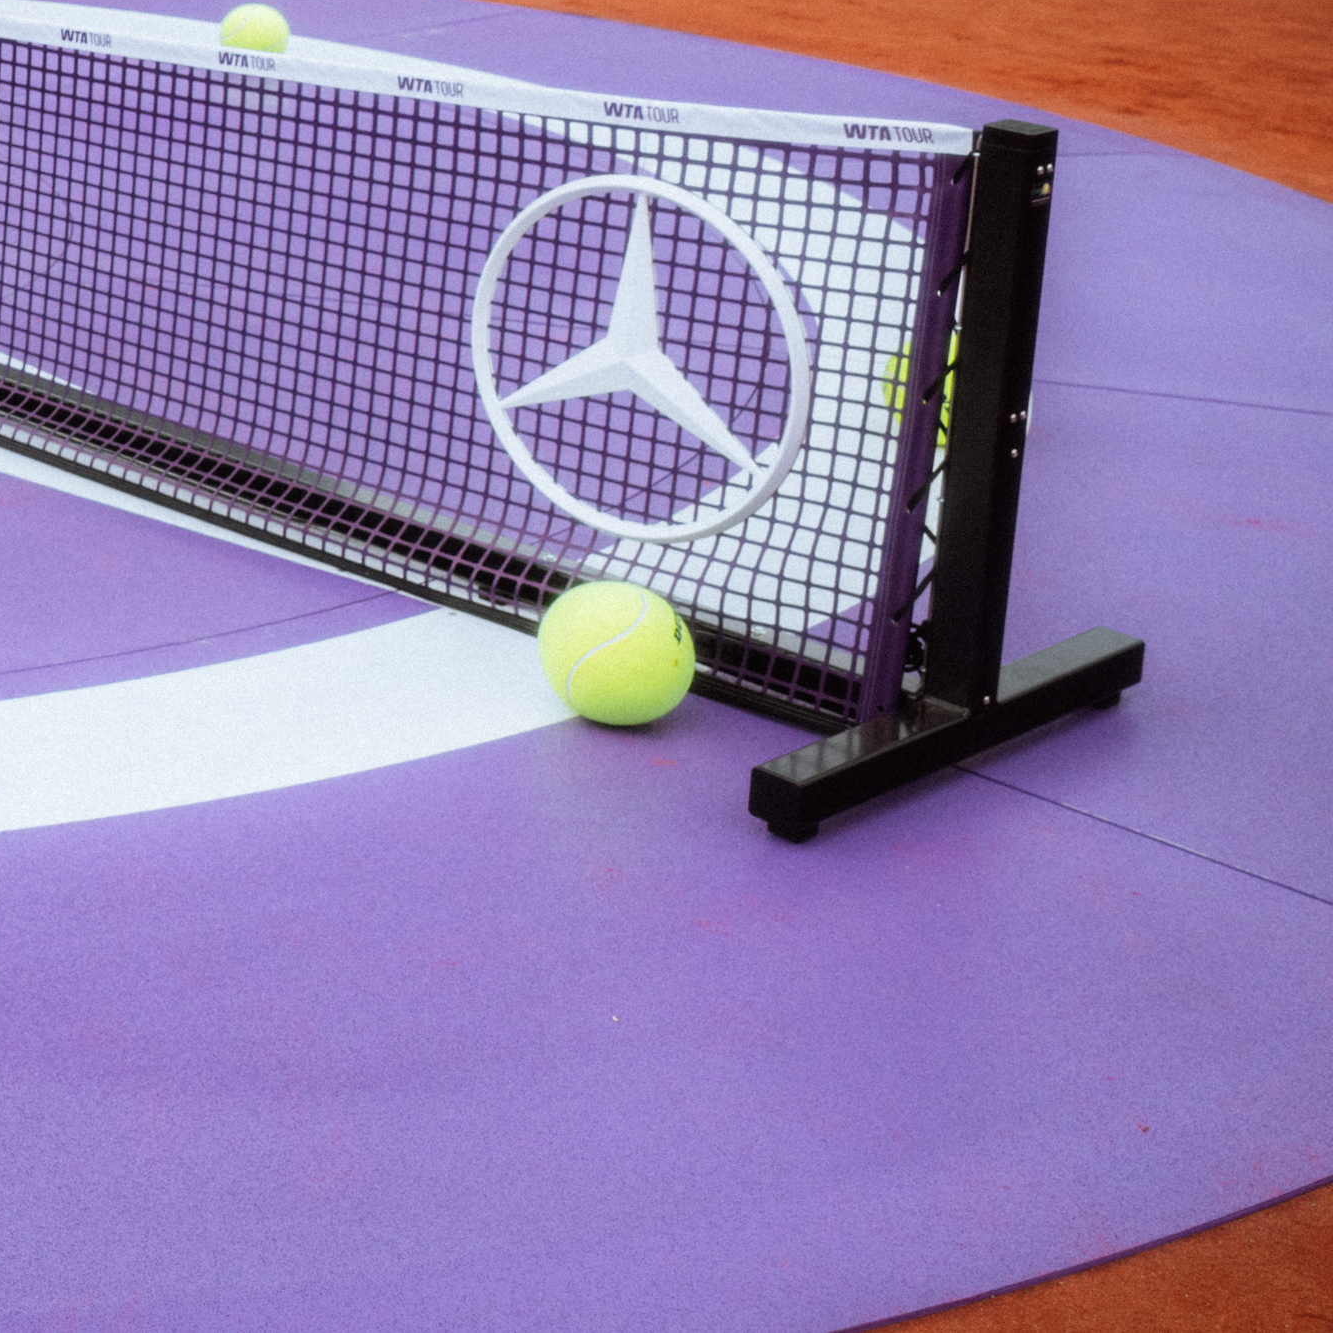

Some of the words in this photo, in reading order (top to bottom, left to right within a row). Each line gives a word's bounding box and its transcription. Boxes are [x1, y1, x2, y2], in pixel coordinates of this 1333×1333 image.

[61, 28, 88, 45] WTA
[89, 31, 113, 48] TOUR
[218, 51, 249, 67] WTA
[250, 55, 277, 72] TOUR
[397, 75, 432, 94] WTA
[434, 80, 465, 98] TOUR
[603, 101, 644, 120] WTA
[645, 105, 680, 124] TOUR
[843, 123, 892, 142] WTA
[893, 126, 935, 145] TOUR
